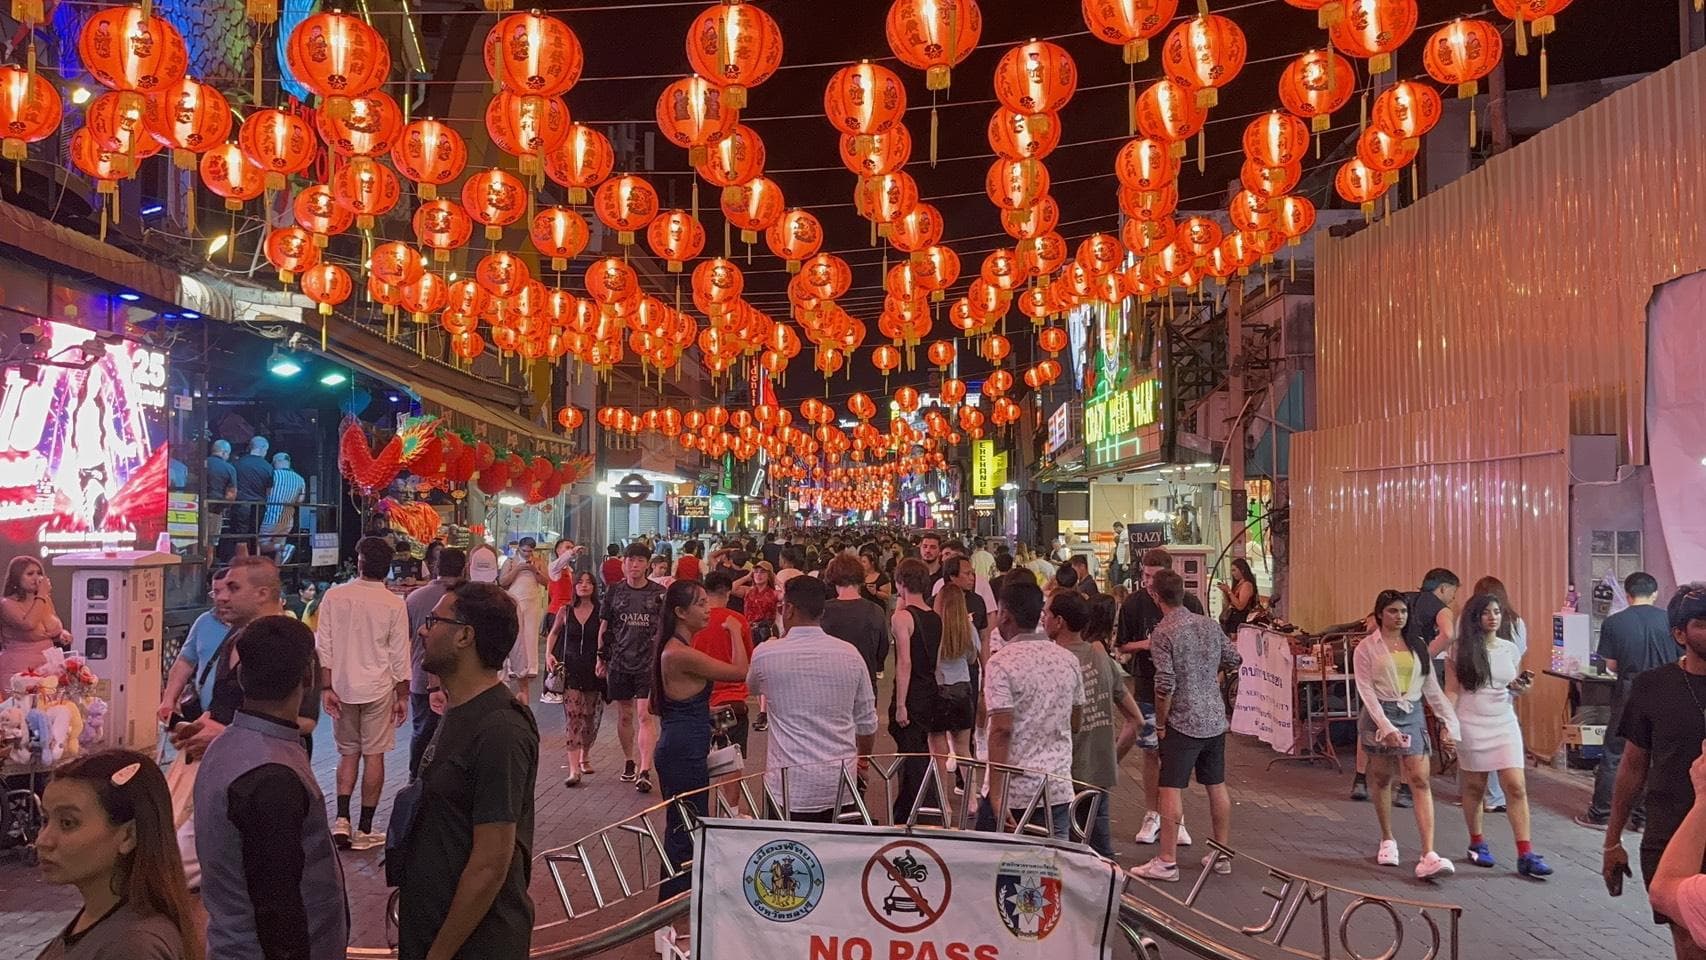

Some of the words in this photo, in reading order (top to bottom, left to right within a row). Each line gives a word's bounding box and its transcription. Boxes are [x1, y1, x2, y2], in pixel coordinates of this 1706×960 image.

[132, 348, 166, 388] 25
[979, 441, 987, 495] EXCHANGE
[1130, 531, 1162, 543] CRAZY
[620, 612, 650, 623] QATAR
[810, 935, 872, 960] NO
